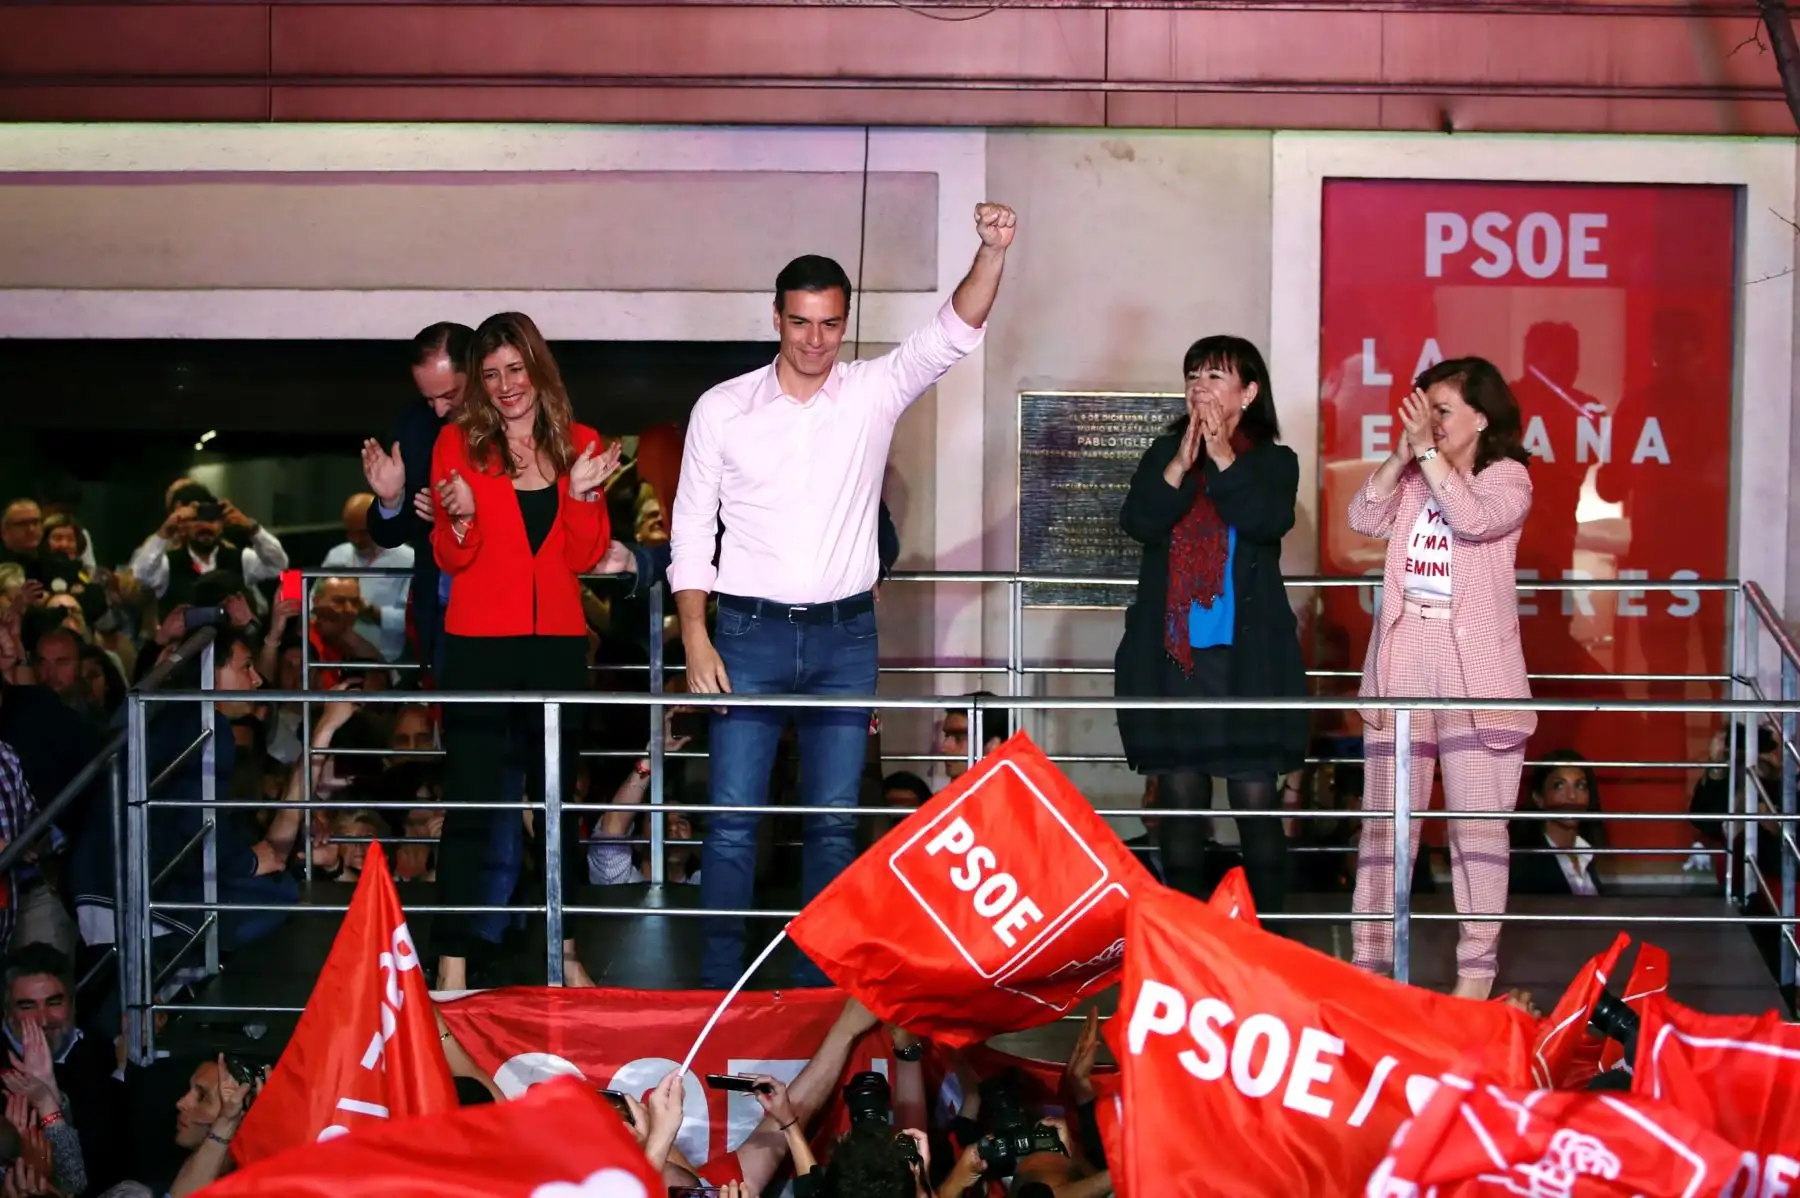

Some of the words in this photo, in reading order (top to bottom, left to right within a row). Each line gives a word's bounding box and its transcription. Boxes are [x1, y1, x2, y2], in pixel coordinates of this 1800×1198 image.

[1425, 211, 1608, 280] PSOE
[1362, 338, 1444, 386] LA
[1077, 436, 1117, 448] PABLO
[1119, 437, 1155, 448] IGLES
[1362, 402, 1671, 465] EAÑA
[1405, 556, 1450, 577] EMINI
[924, 816, 1044, 948] PSOE
[1127, 979, 1344, 1117] PSOE
